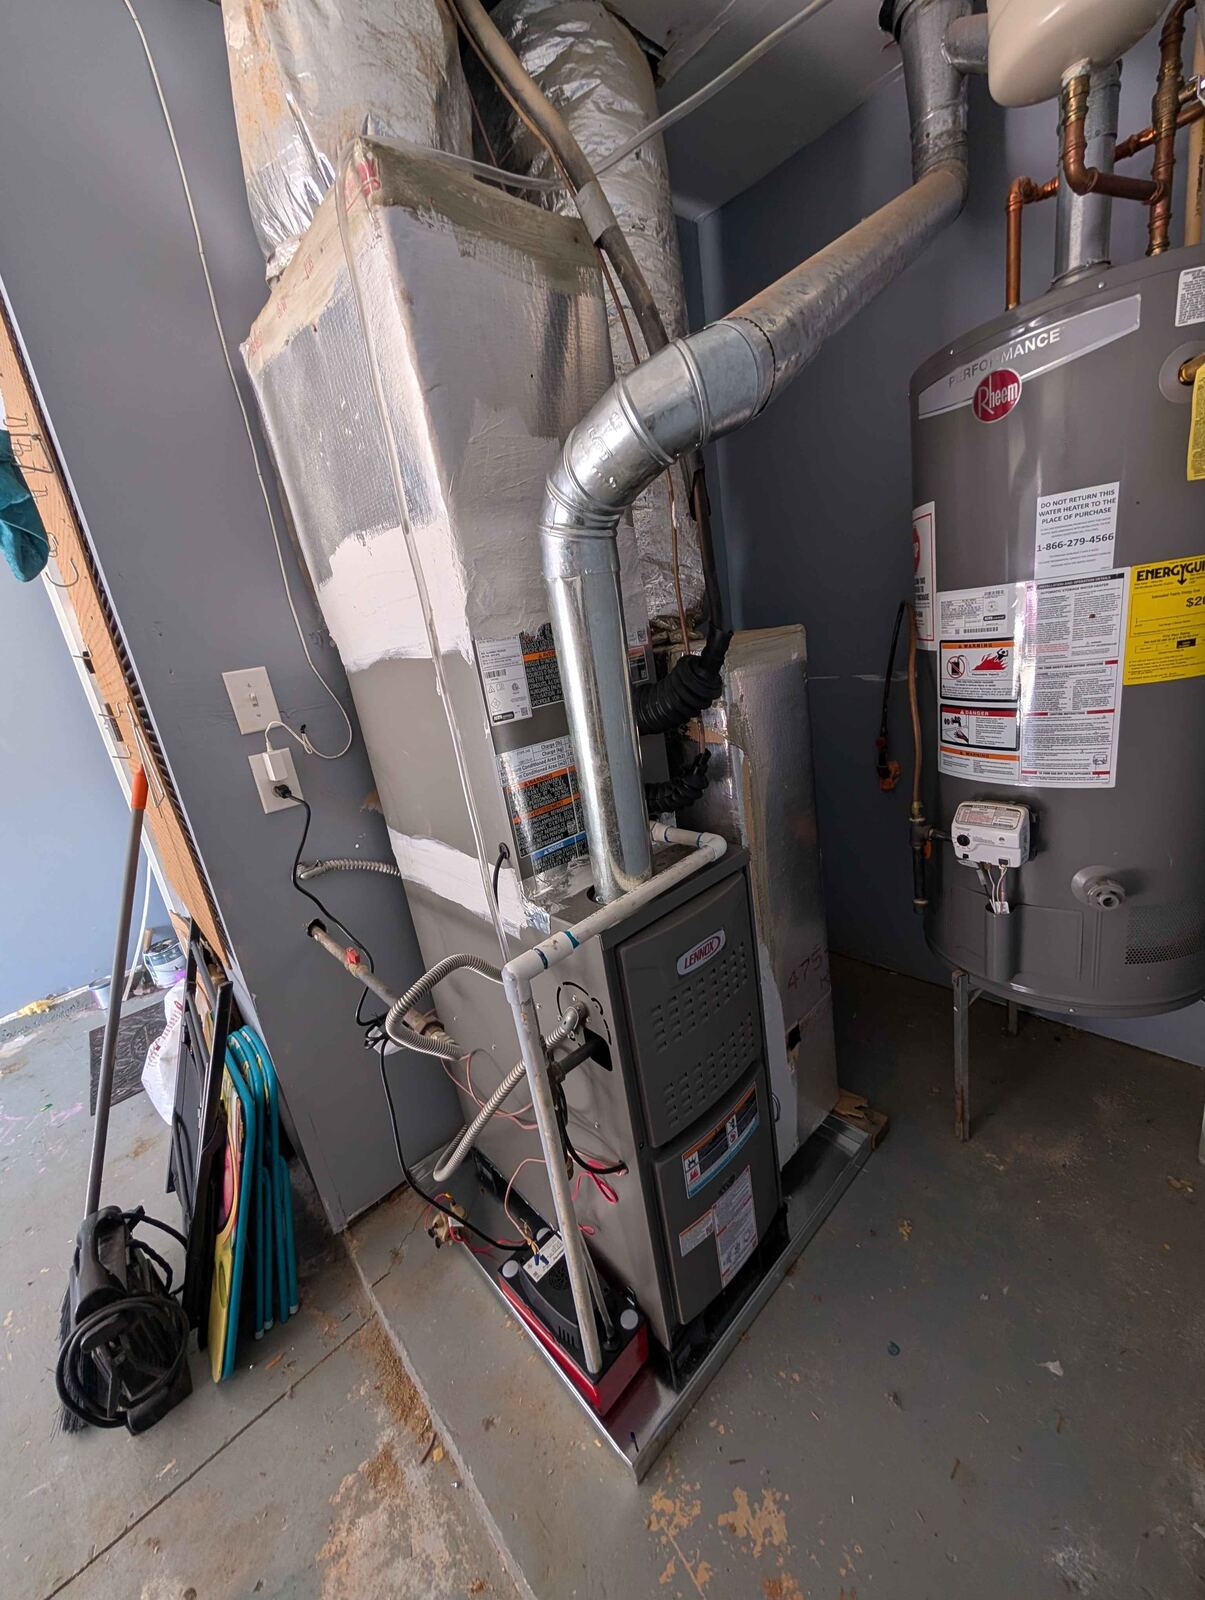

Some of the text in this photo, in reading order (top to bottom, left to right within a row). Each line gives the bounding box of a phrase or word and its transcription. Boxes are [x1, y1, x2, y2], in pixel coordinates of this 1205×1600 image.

[978, 374, 1018, 418] Rheem
[1038, 507, 1062, 517] WATER
[1063, 501, 1089, 512] HEATER
[1103, 497, 1116, 505] THE
[1052, 498, 1067, 506] NOT
[1069, 492, 1097, 503] RETURN
[1099, 489, 1115, 497] THIS
[1041, 506, 1112, 525] PLACE OF PURCHASE
[1037, 532, 1114, 552] 1-866-279-4566
[542, 749, 556, 757] Charge
[522, 760, 546, 770] Conditioned
[523, 767, 548, 777] Conditioned
[684, 940, 714, 969] LENNOX
